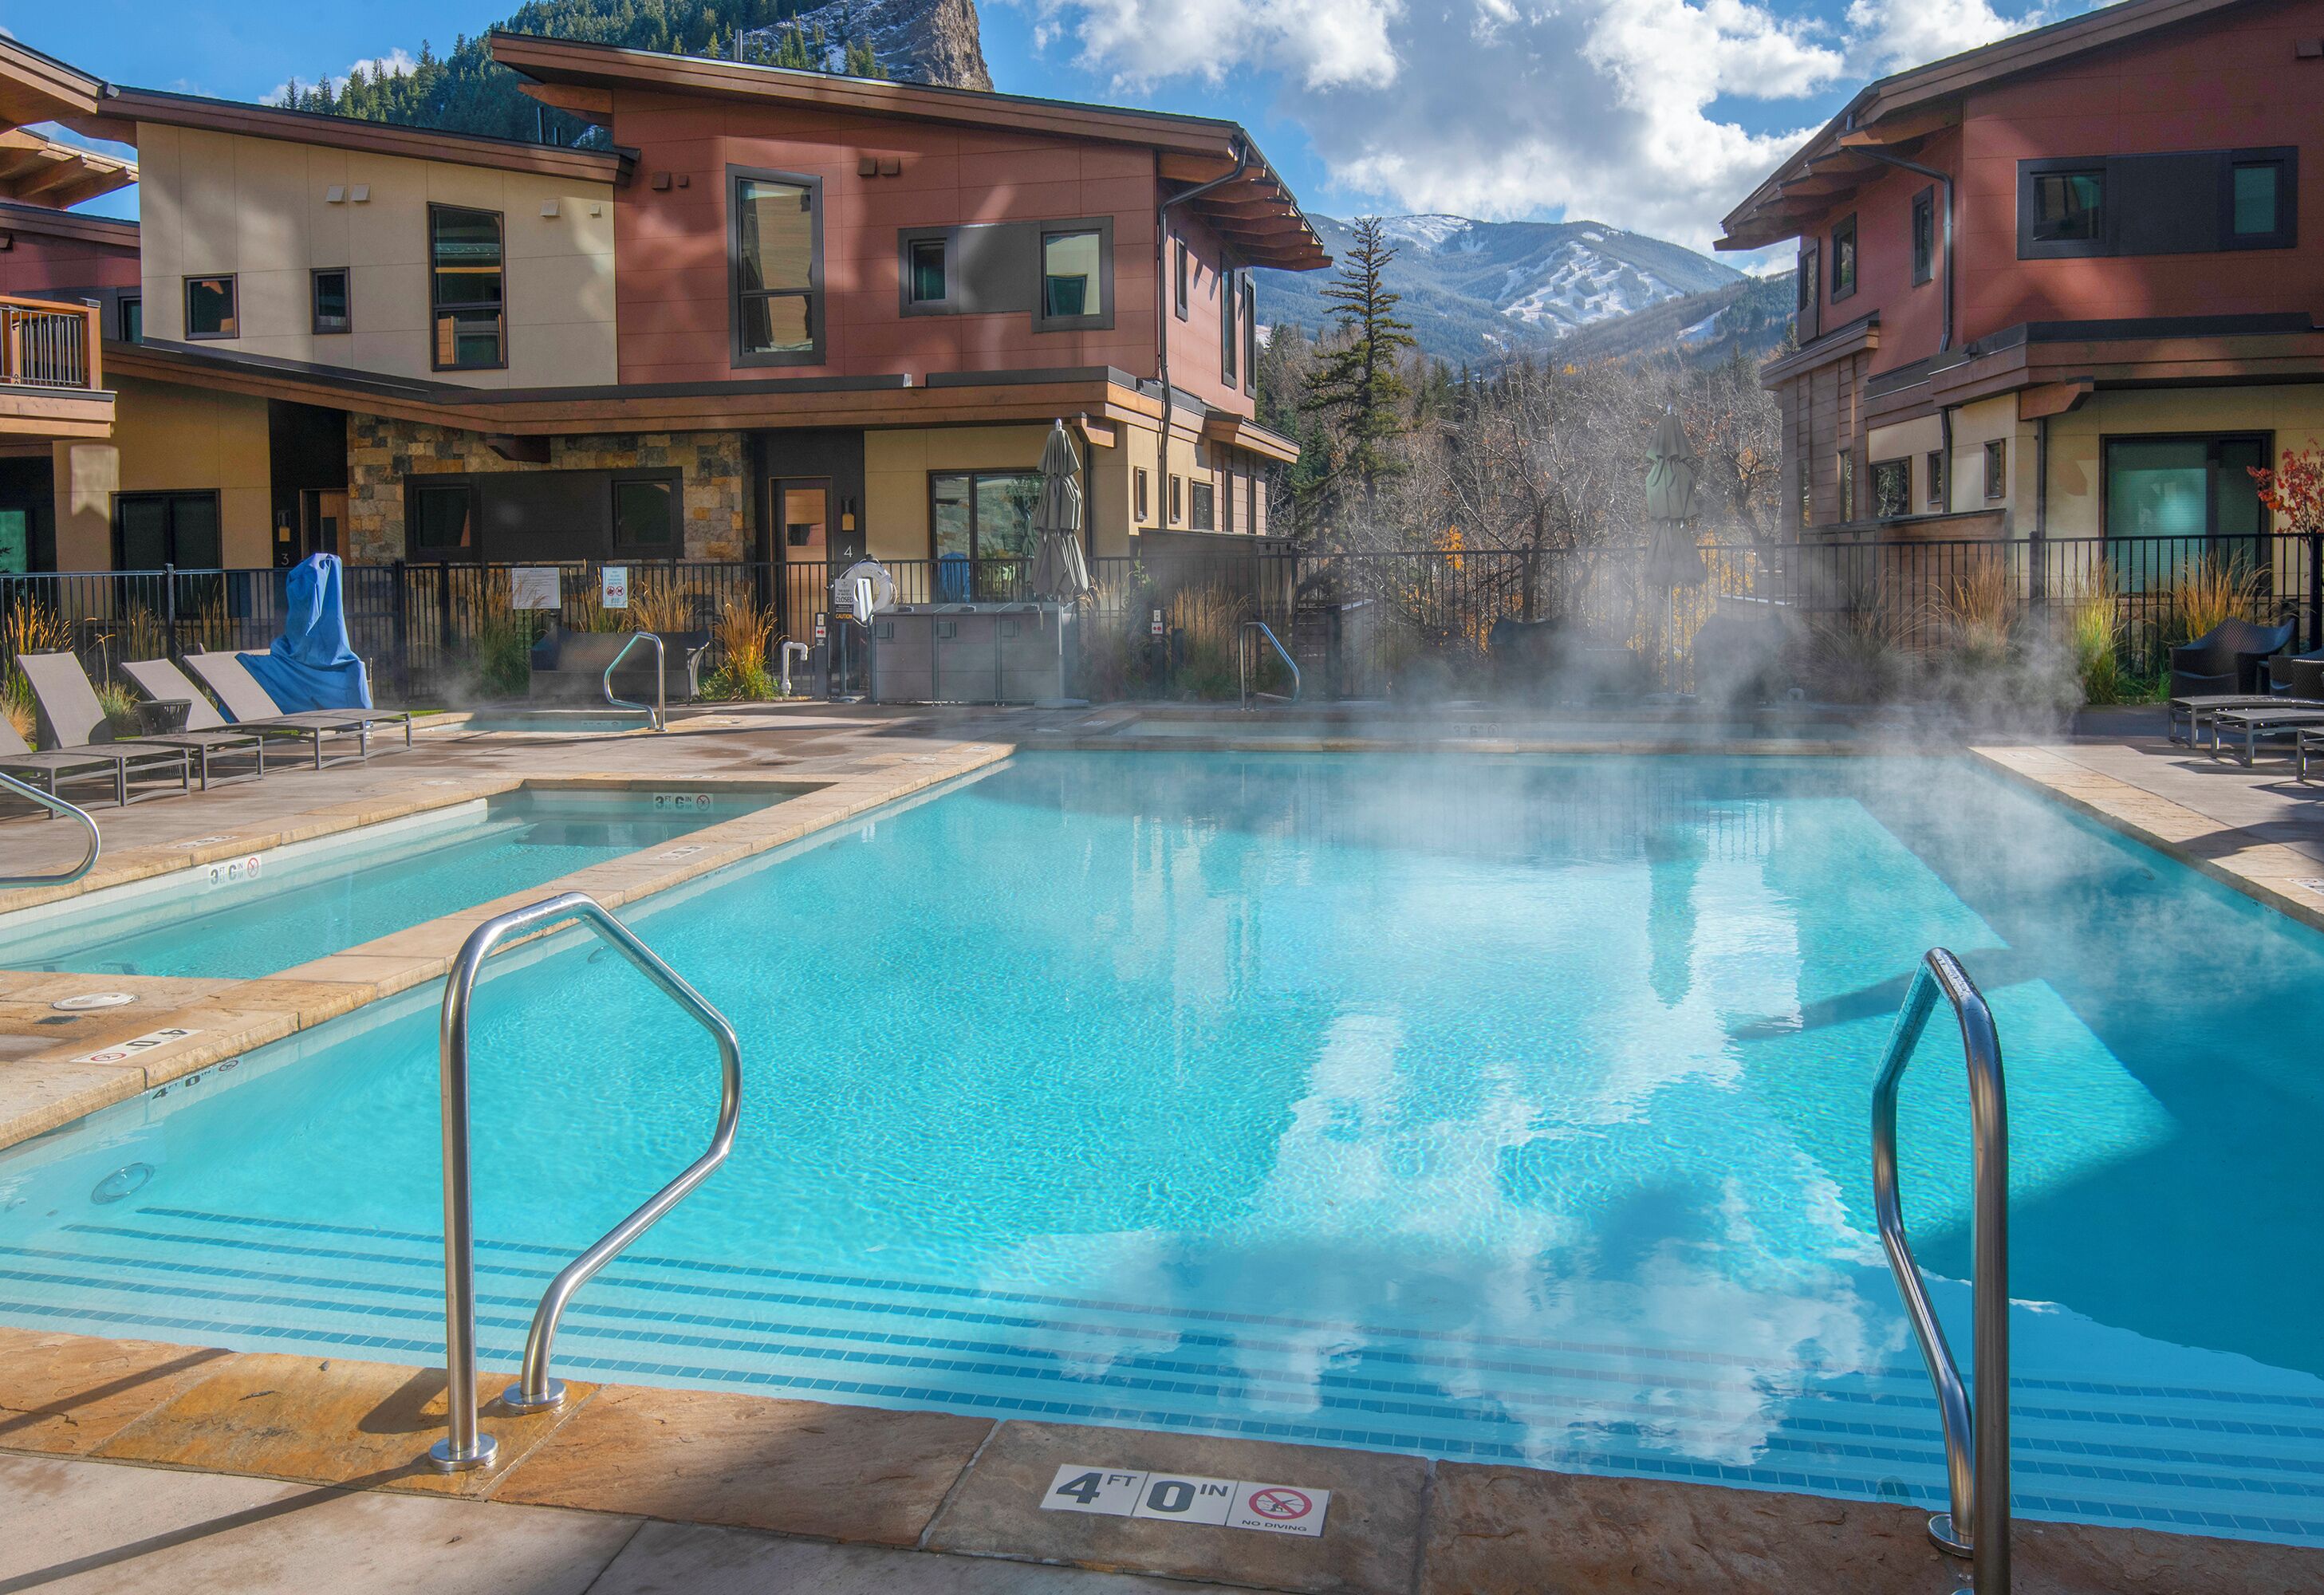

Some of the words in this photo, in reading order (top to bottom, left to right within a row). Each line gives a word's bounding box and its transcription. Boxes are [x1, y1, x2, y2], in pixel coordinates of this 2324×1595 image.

[844, 545, 853, 557] 4
[281, 553, 289, 565] 3
[152, 1088, 168, 1100] 4
[1056, 1472, 1103, 1504] 4
[1106, 1474, 1137, 1487] FT
[1146, 1480, 1196, 1513] 0
[1199, 1483, 1229, 1497] IN
[1265, 1522, 1307, 1532] DIVING
